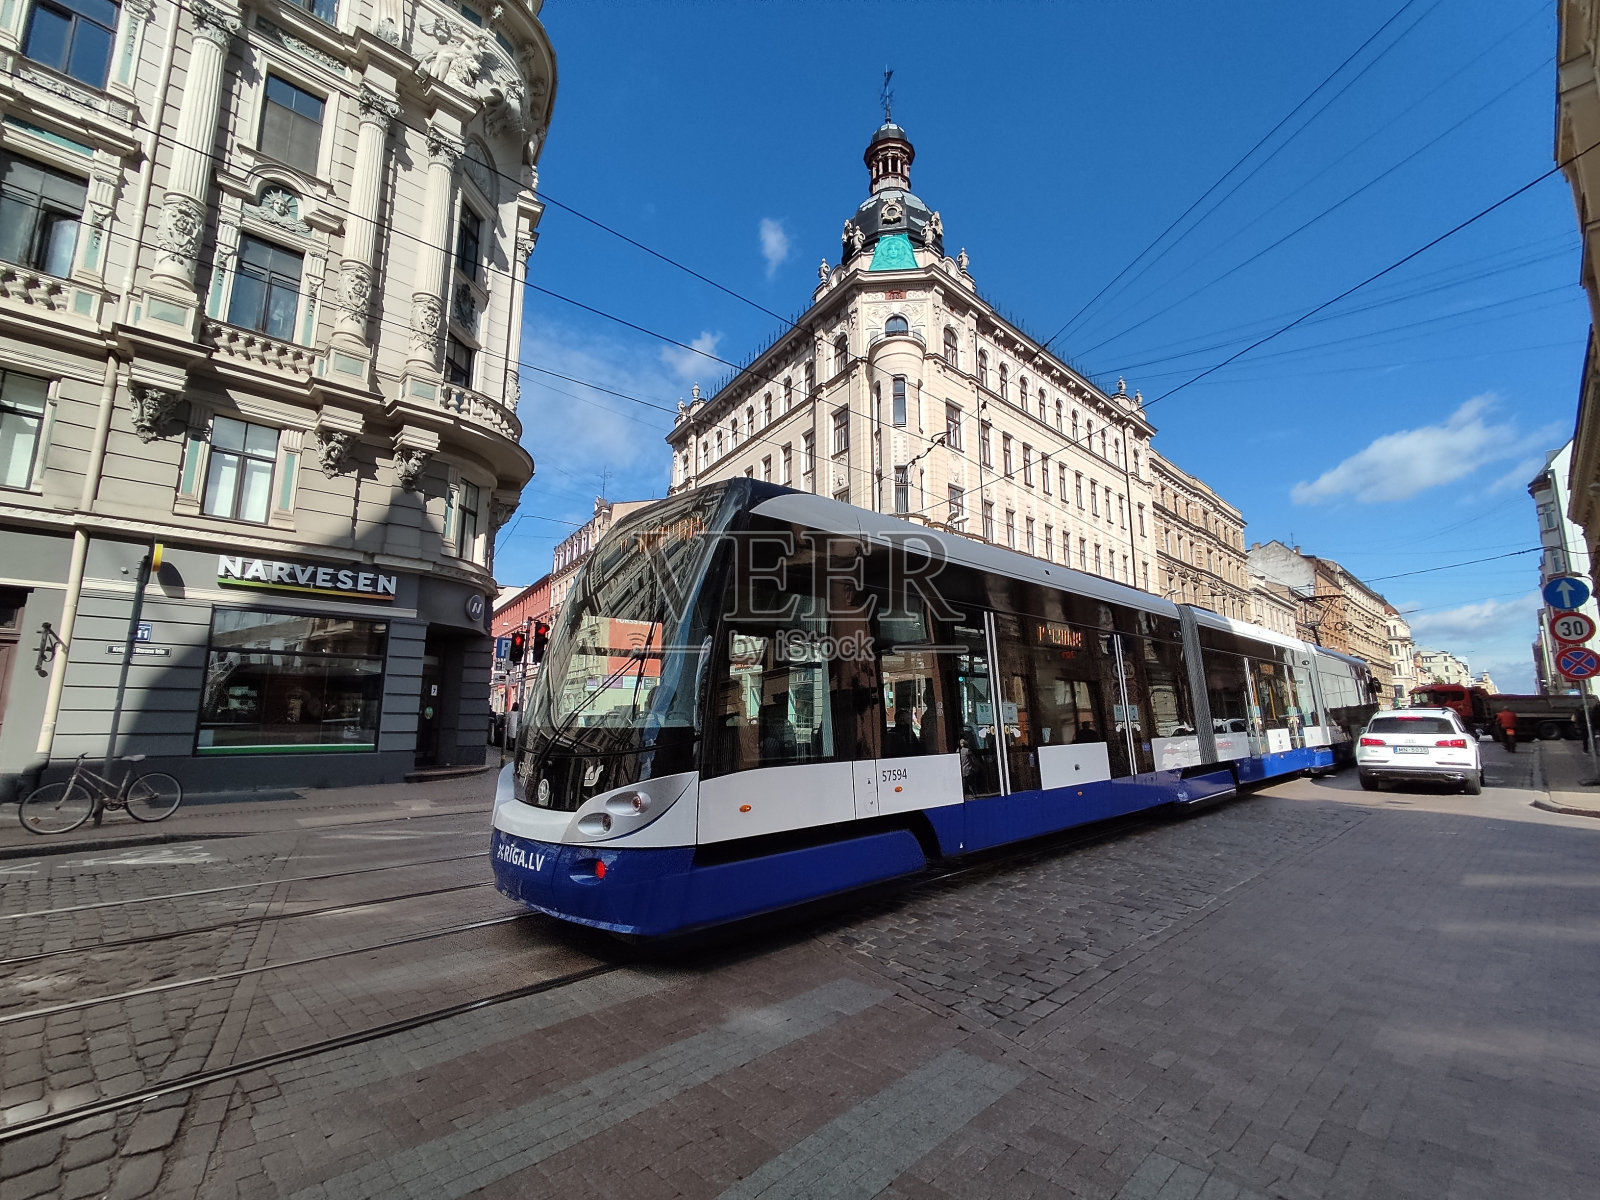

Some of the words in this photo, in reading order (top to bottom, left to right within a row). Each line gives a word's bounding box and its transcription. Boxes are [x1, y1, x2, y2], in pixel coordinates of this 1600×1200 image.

[216, 554, 397, 595] NARVESEN
[1560, 620, 1584, 637] 30
[882, 768, 907, 782] 57594
